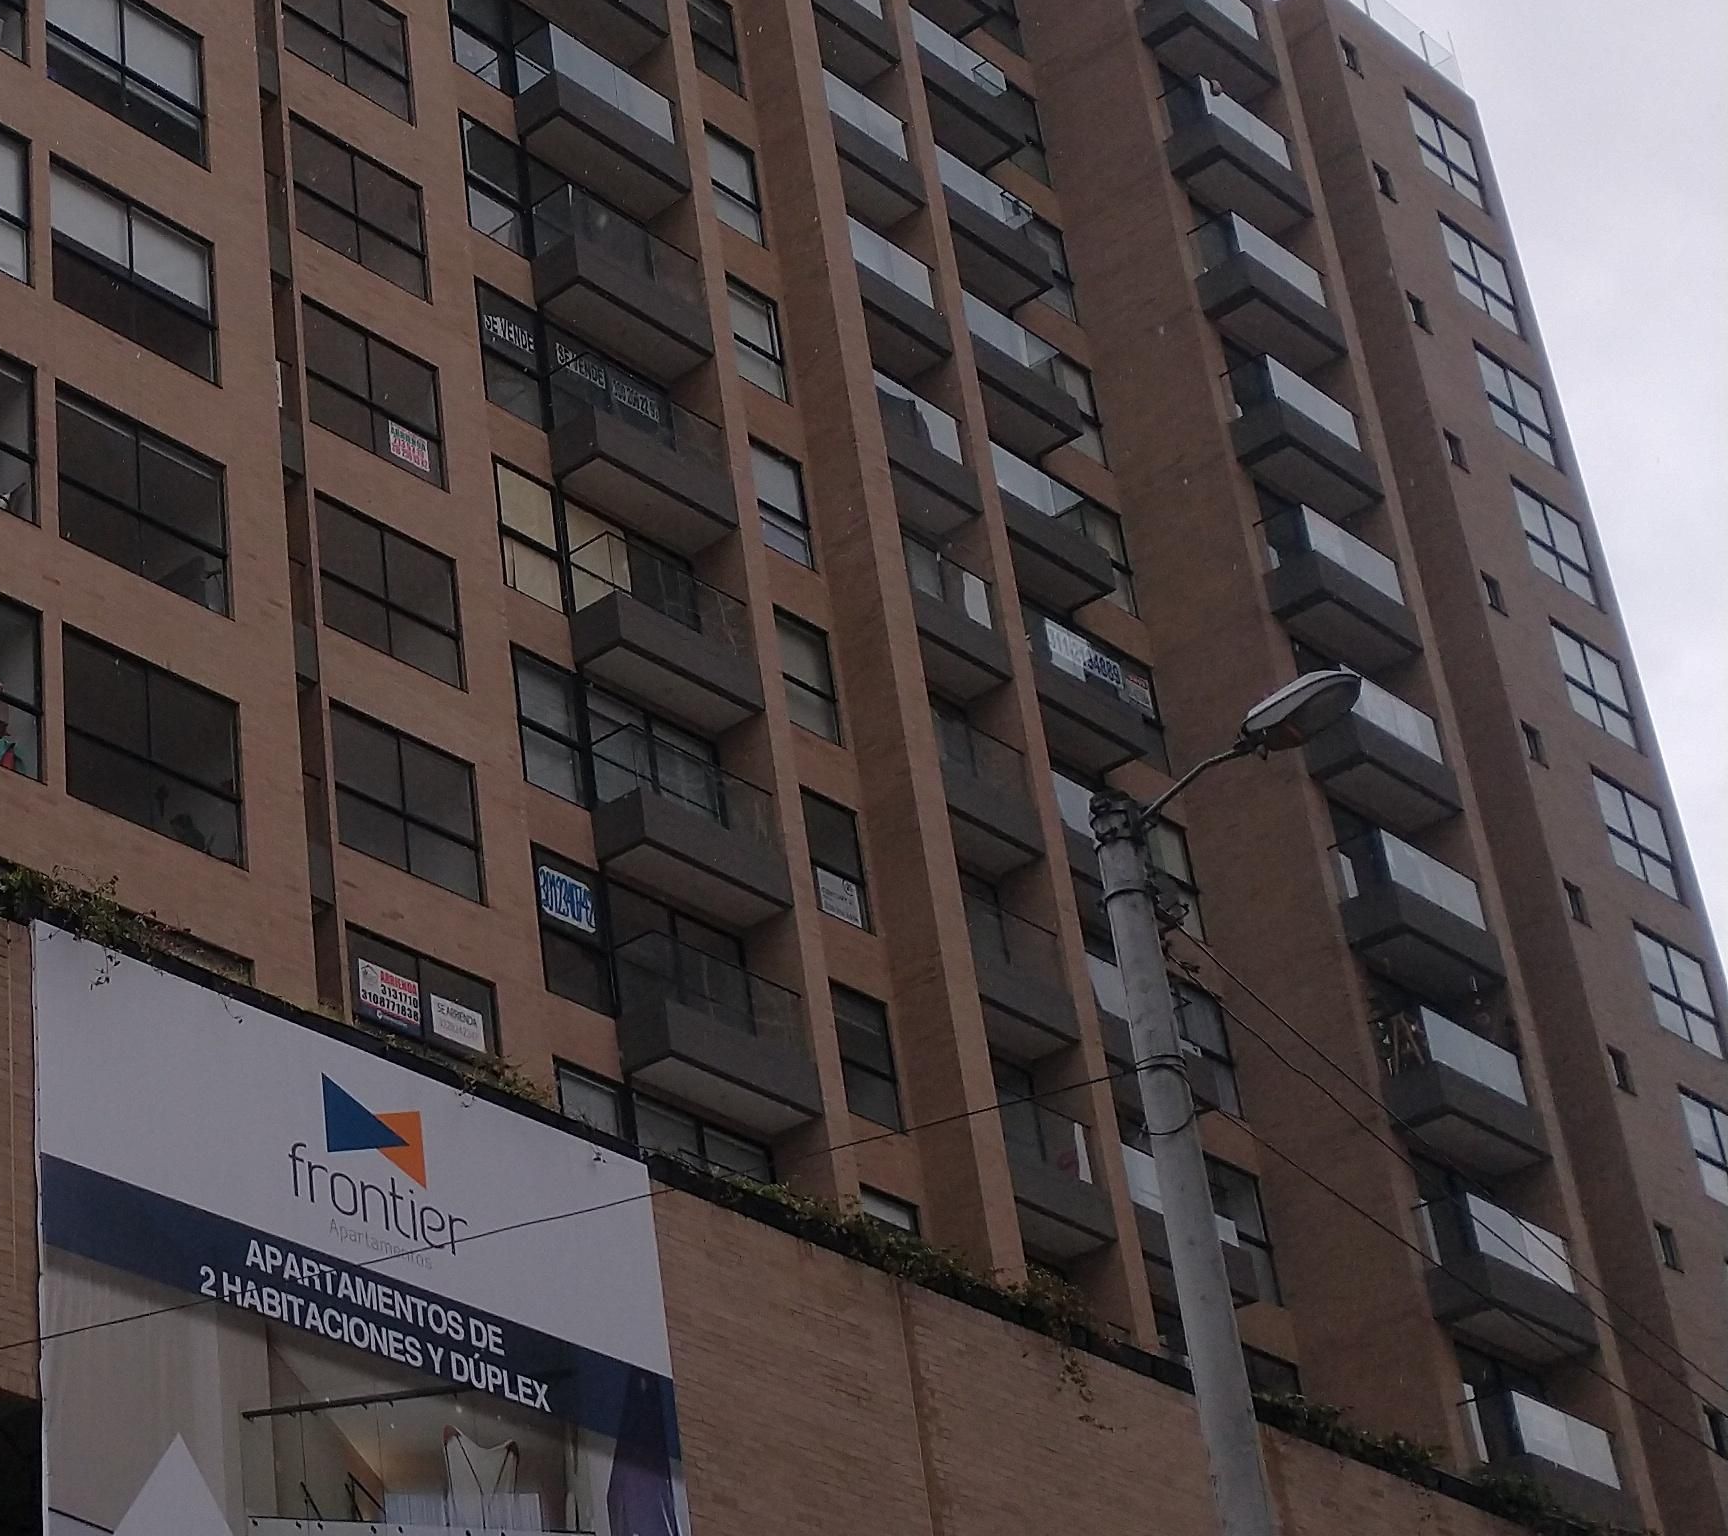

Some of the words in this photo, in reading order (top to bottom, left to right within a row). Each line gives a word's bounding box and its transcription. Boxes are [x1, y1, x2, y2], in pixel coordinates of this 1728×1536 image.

[499, 318, 535, 354] VENDE
[380, 984, 419, 1009] 3131710
[288, 1142, 468, 1256] frontier
[329, 1218, 433, 1270] Apartamentos
[199, 1265, 217, 1298] 2
[222, 1271, 424, 1367] HABITACIONES
[424, 1343, 445, 1375] Y
[450, 1351, 552, 1413] DÚPLEX
[245, 1239, 465, 1341] APARTAMENTOS
[470, 1316, 506, 1356] DE
